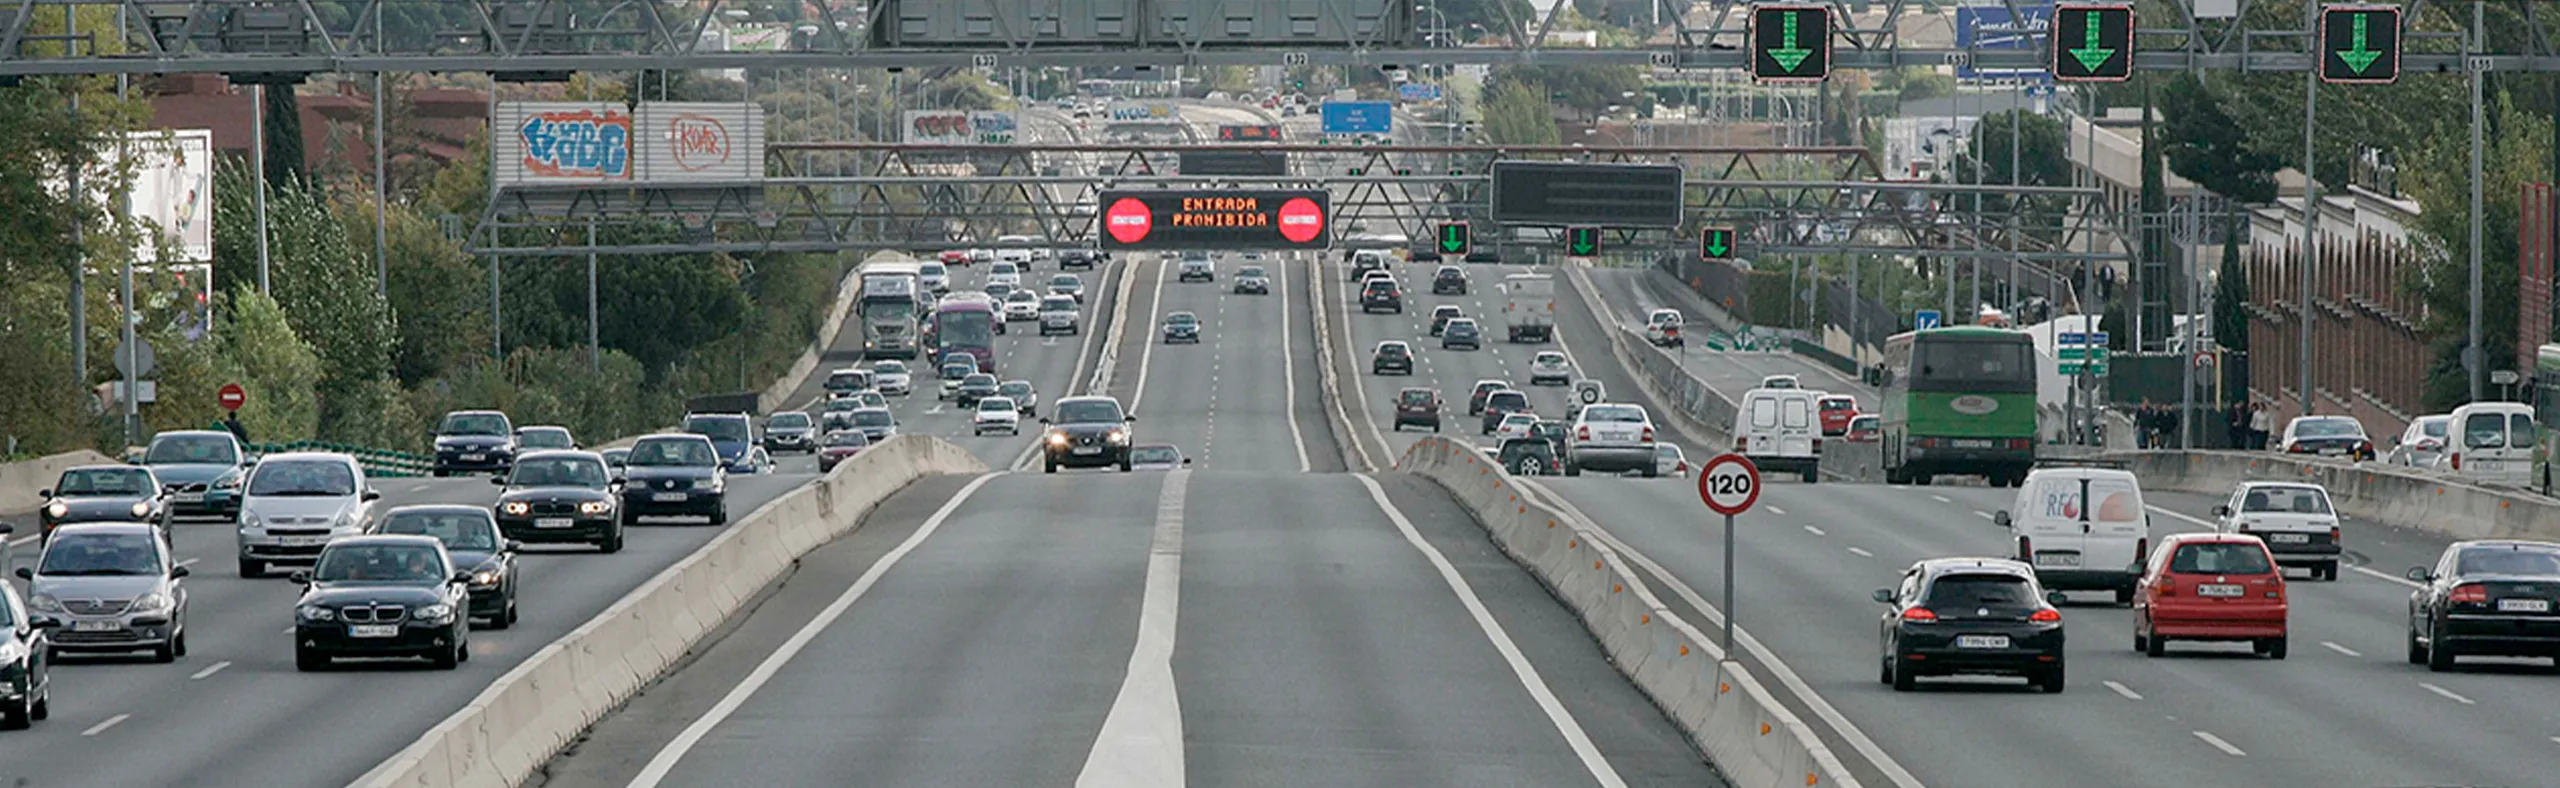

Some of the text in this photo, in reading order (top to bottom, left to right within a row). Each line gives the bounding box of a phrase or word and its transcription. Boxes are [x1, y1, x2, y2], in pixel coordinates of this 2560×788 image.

[1182, 198, 1257, 211] ENTRADA
[1173, 213, 1267, 227] PROHIBIDA
[1709, 474, 1750, 494] 120
